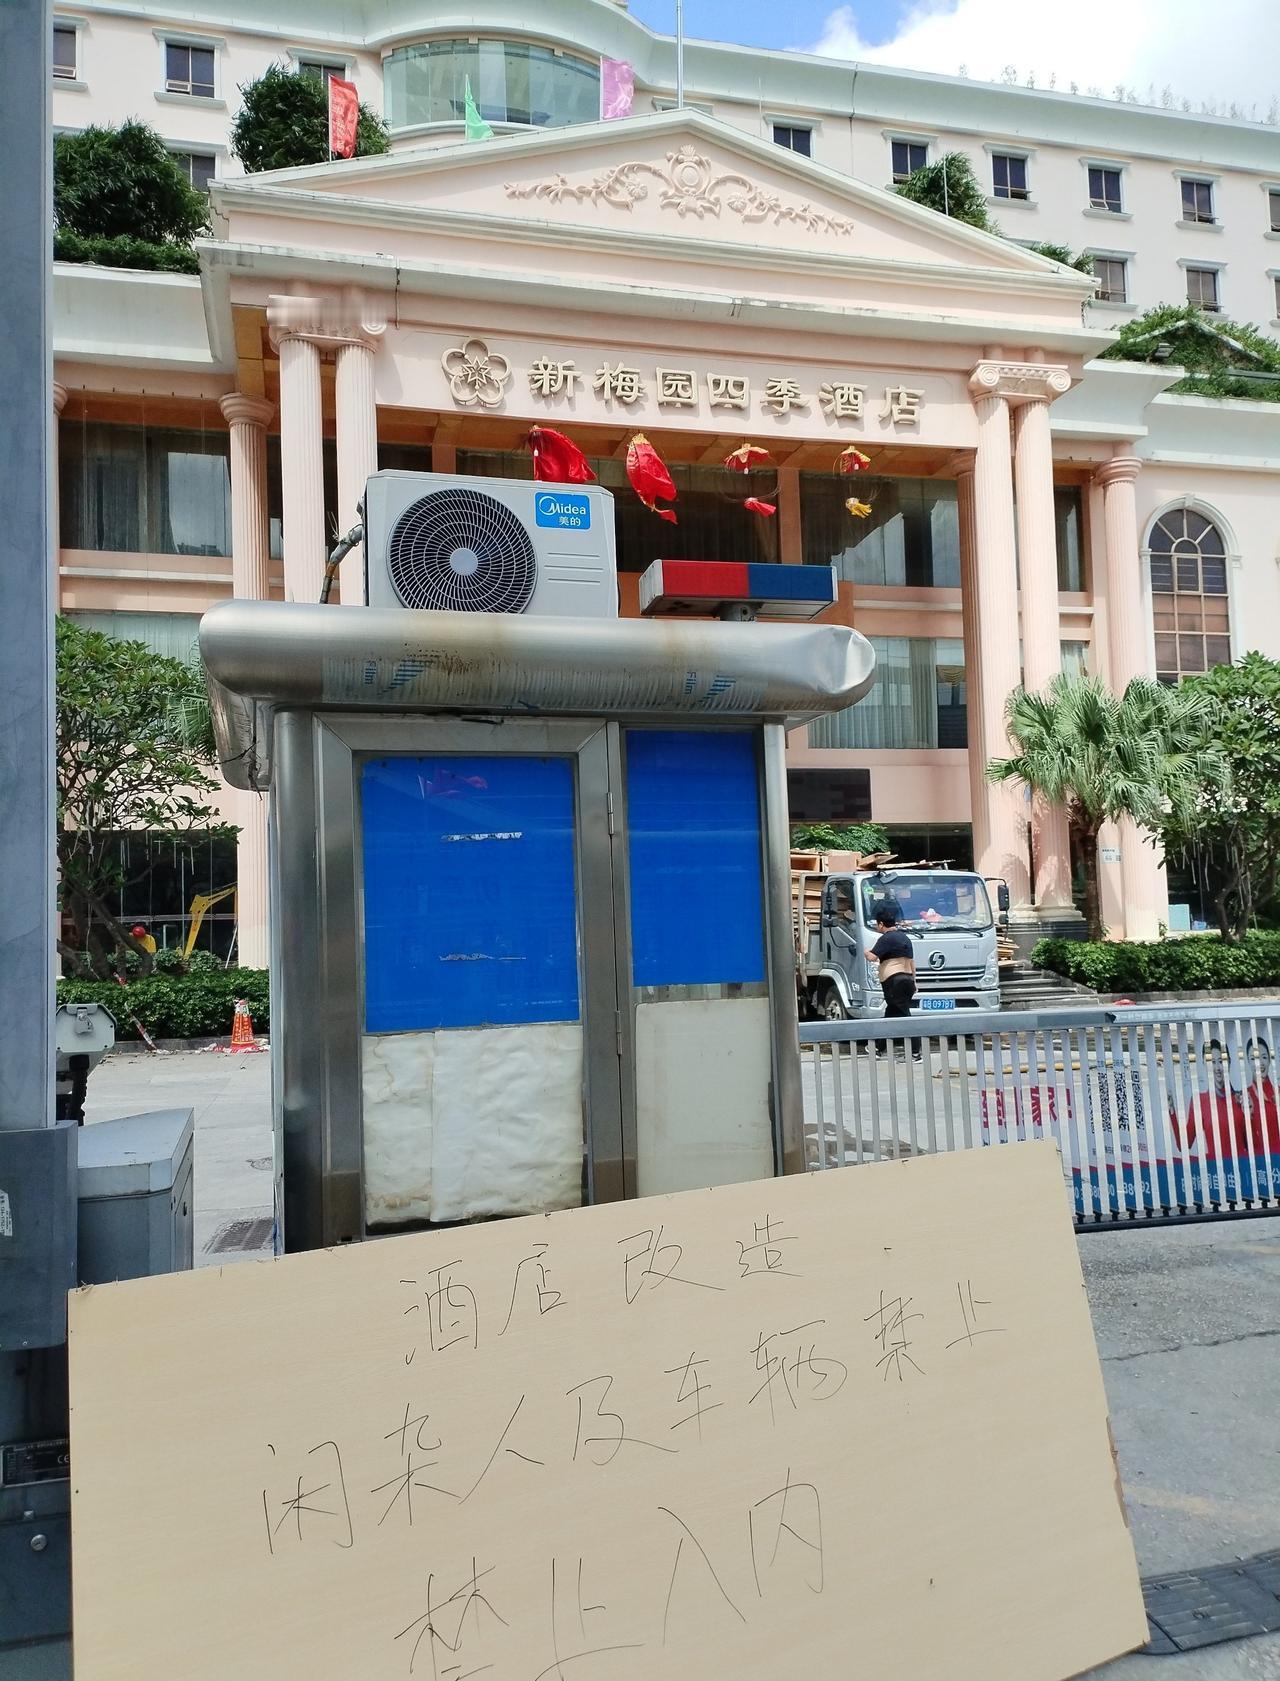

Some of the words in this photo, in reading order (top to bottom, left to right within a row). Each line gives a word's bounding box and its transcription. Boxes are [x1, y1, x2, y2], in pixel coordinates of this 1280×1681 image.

[527, 355, 926, 425] 新梅园四季酒店
[541, 498, 586, 515] Midea
[559, 516, 581, 527] 美的
[399, 1214, 804, 1365] 酒店改造
[263, 1280, 1007, 1554] 闲杂人及车辆禁止
